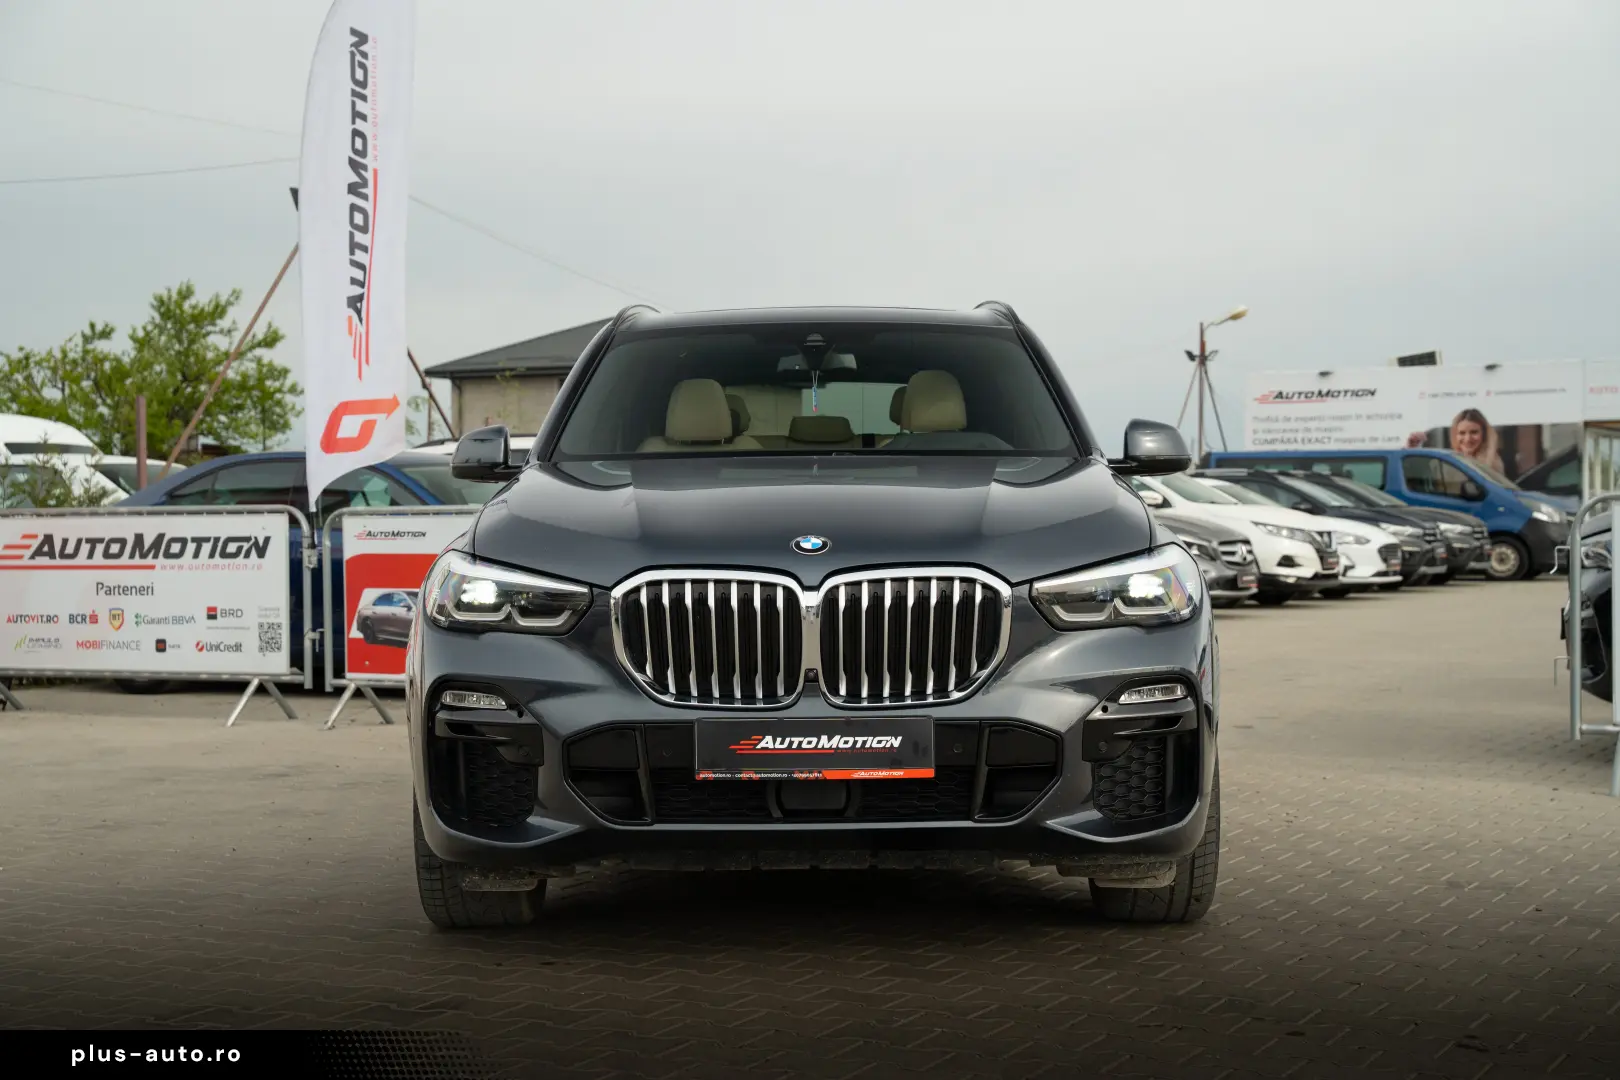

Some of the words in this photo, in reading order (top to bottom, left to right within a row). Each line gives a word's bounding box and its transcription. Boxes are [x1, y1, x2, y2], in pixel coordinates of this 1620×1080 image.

[160, 562, 263, 572] www.automotion.ro
[96, 582, 154, 596] Parteneri
[220, 608, 243, 618] BRD
[6, 614, 59, 624] AUTOVIT.RO
[68, 613, 87, 624] BCR
[142, 615, 170, 625] Garanti
[171, 615, 196, 625] BBVA
[76, 639, 141, 651] MOBIFINANCE
[206, 641, 243, 652] UniCredit
